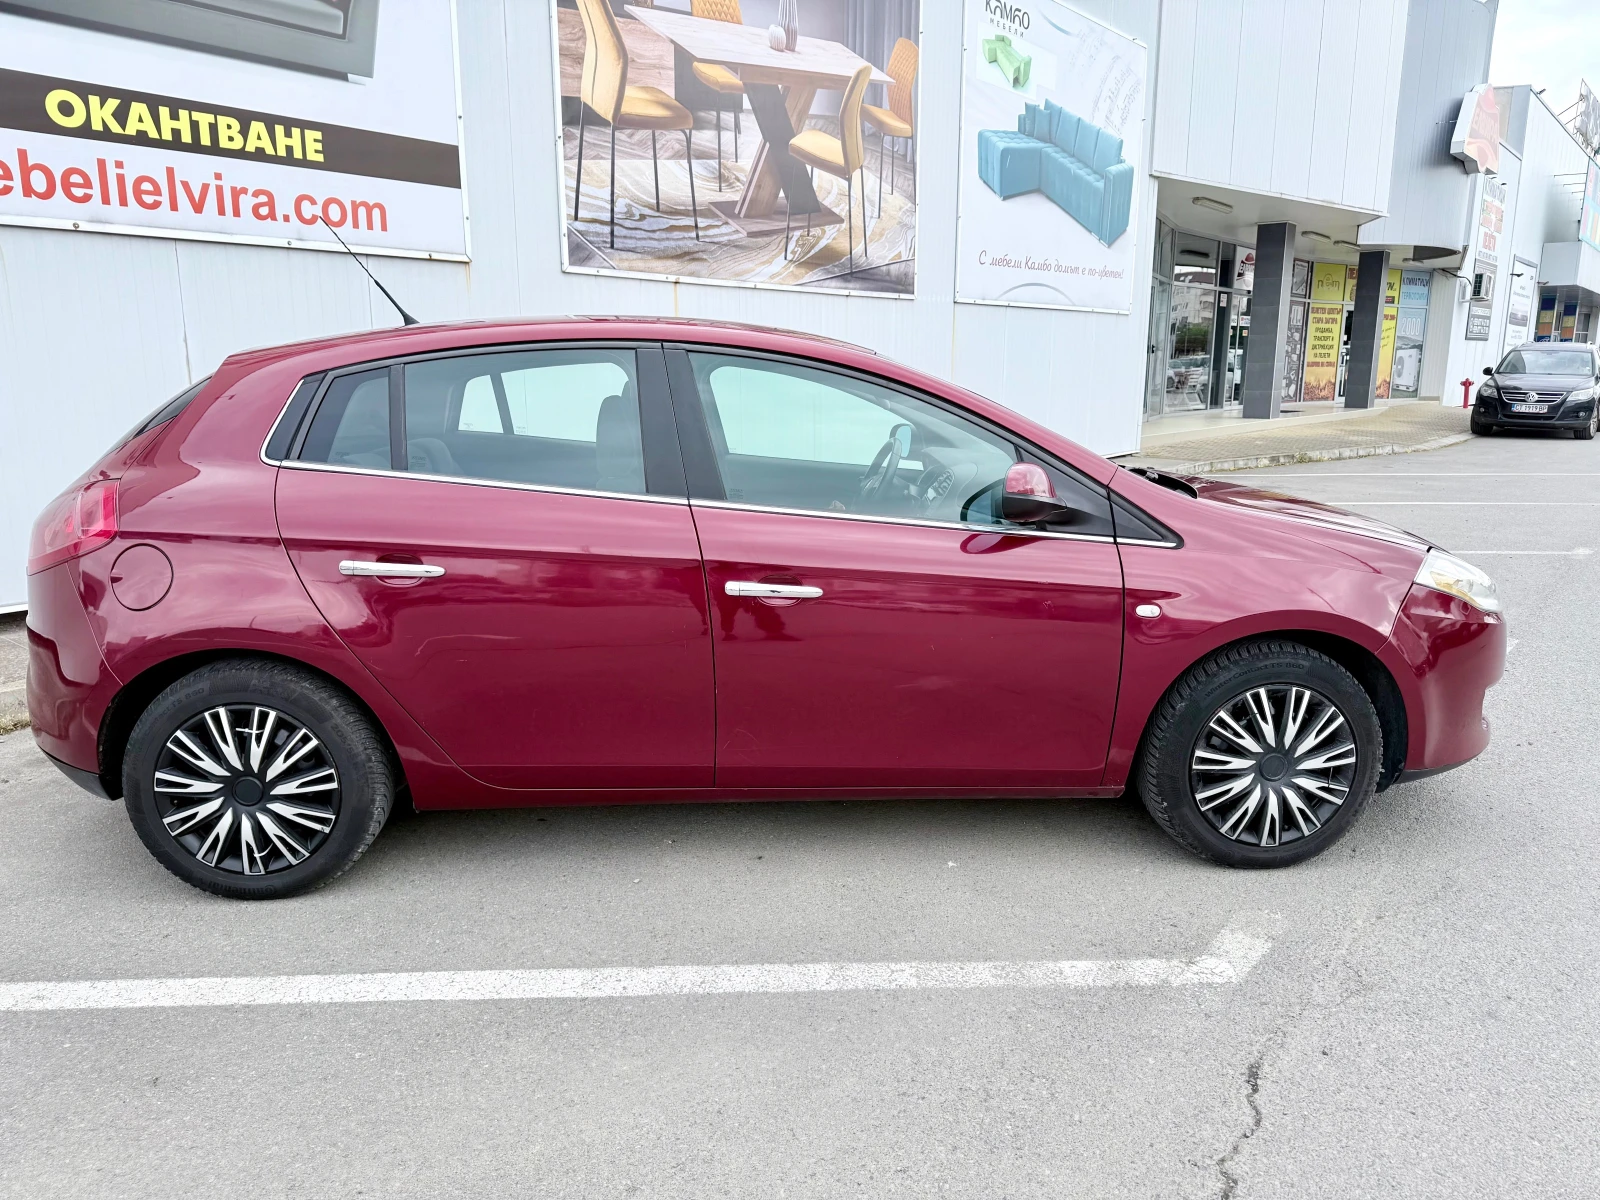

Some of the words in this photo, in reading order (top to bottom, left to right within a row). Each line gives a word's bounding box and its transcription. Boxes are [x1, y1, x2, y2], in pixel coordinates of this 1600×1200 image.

[990, 17, 1024, 38] МЕБЕЛИ
[45, 89, 324, 162] ОКАНТВАНЕ
[978, 250, 987, 265] С
[989, 253, 1022, 268] мебели
[1024, 255, 1052, 272] Камбо
[1053, 259, 1080, 274] домът
[1081, 267, 1086, 276] е
[1204, 664, 1269, 697] WinterContact
[1285, 662, 1304, 670] 860
